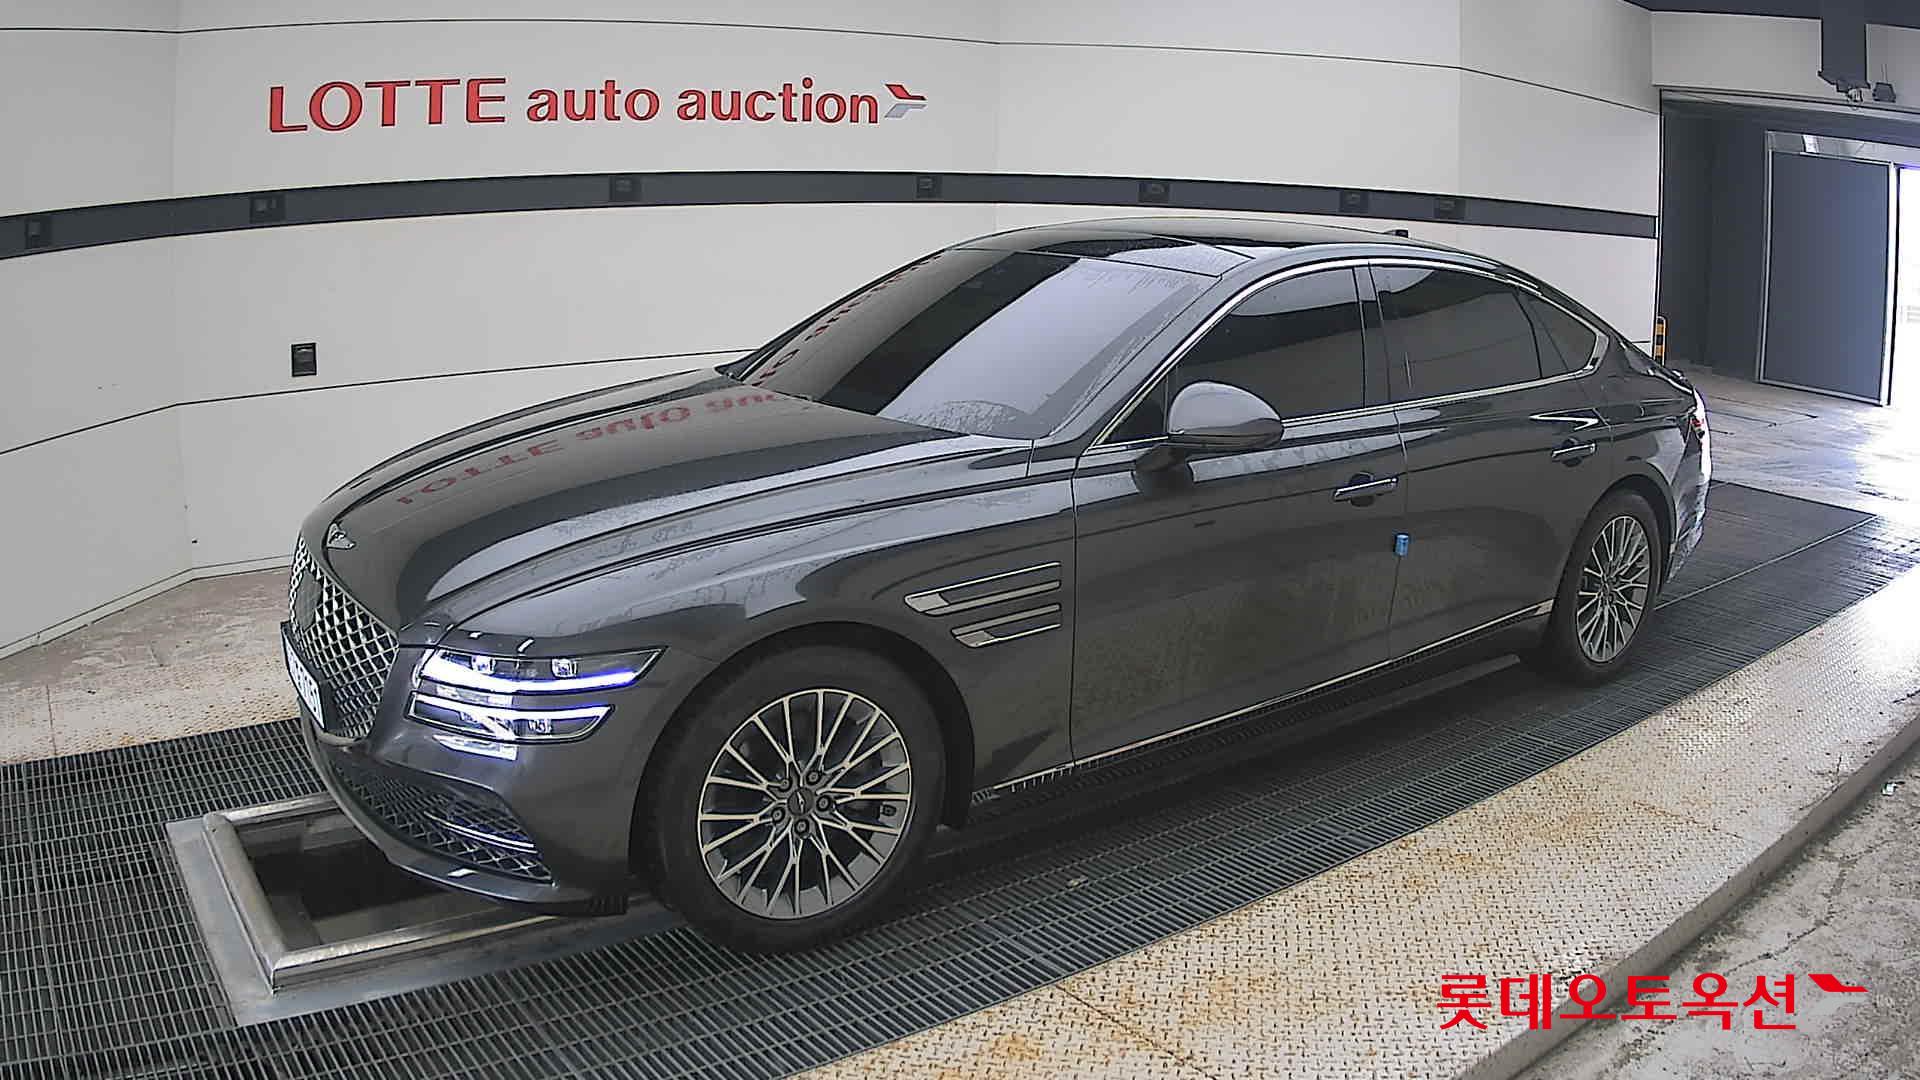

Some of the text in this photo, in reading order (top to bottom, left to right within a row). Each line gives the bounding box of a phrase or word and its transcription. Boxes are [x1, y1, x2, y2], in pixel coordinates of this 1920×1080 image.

[269, 78, 879, 133] LOTTE auto auction
